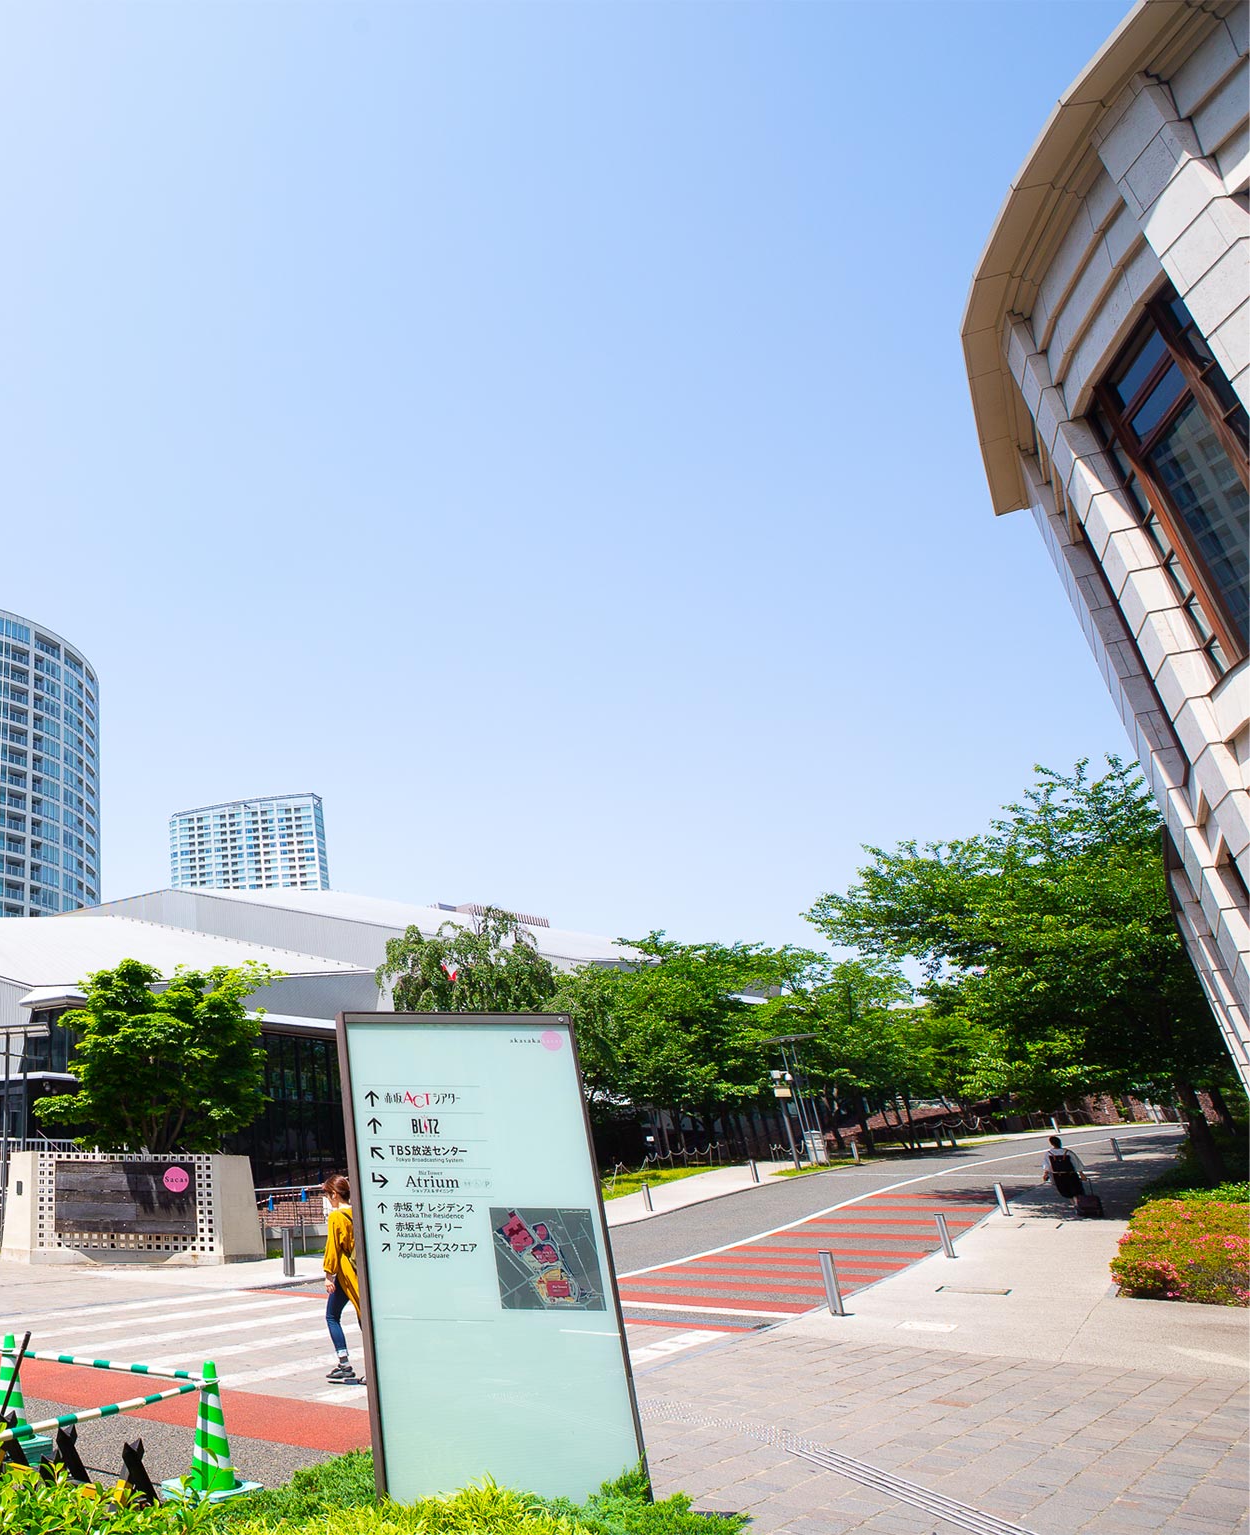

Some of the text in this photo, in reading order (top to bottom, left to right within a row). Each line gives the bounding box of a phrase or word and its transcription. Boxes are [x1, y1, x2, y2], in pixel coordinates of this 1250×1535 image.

[411, 1118, 440, 1134] BLITZ
[389, 1145, 468, 1156] TBS放送センター
[406, 1175, 459, 1188] Atrium
[393, 1202, 475, 1212] 赤坂 ザ レジデンス
[395, 1222, 463, 1232] 赤坂ギャラリー
[397, 1242, 477, 1252] アプローズスクエア
